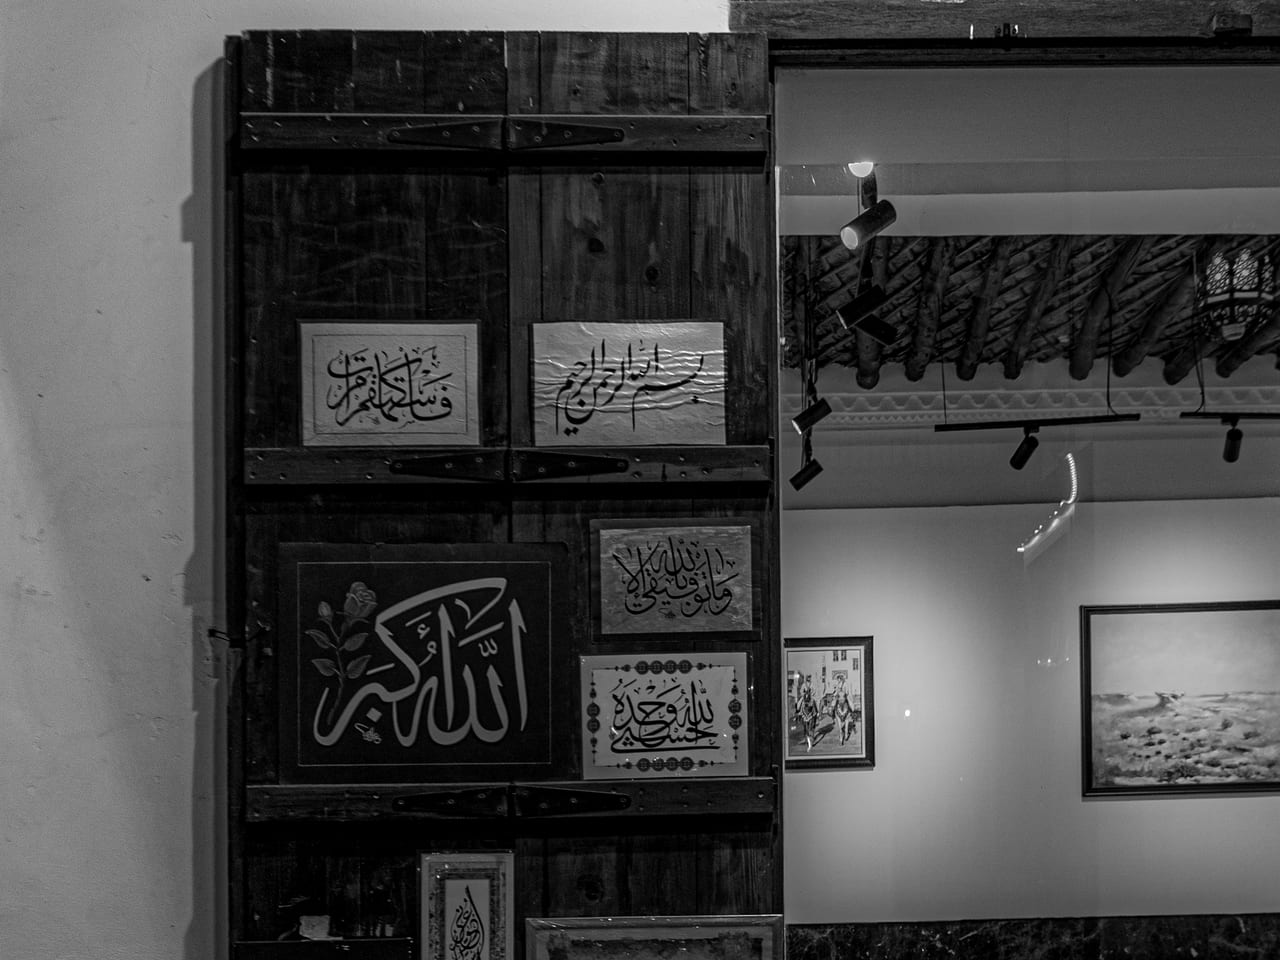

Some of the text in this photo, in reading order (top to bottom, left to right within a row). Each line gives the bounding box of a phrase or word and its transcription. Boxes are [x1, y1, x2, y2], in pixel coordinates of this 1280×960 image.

[556, 338, 606, 436] الرحيم
[631, 354, 704, 432] بسم
[313, 576, 529, 747] الله أكبر
